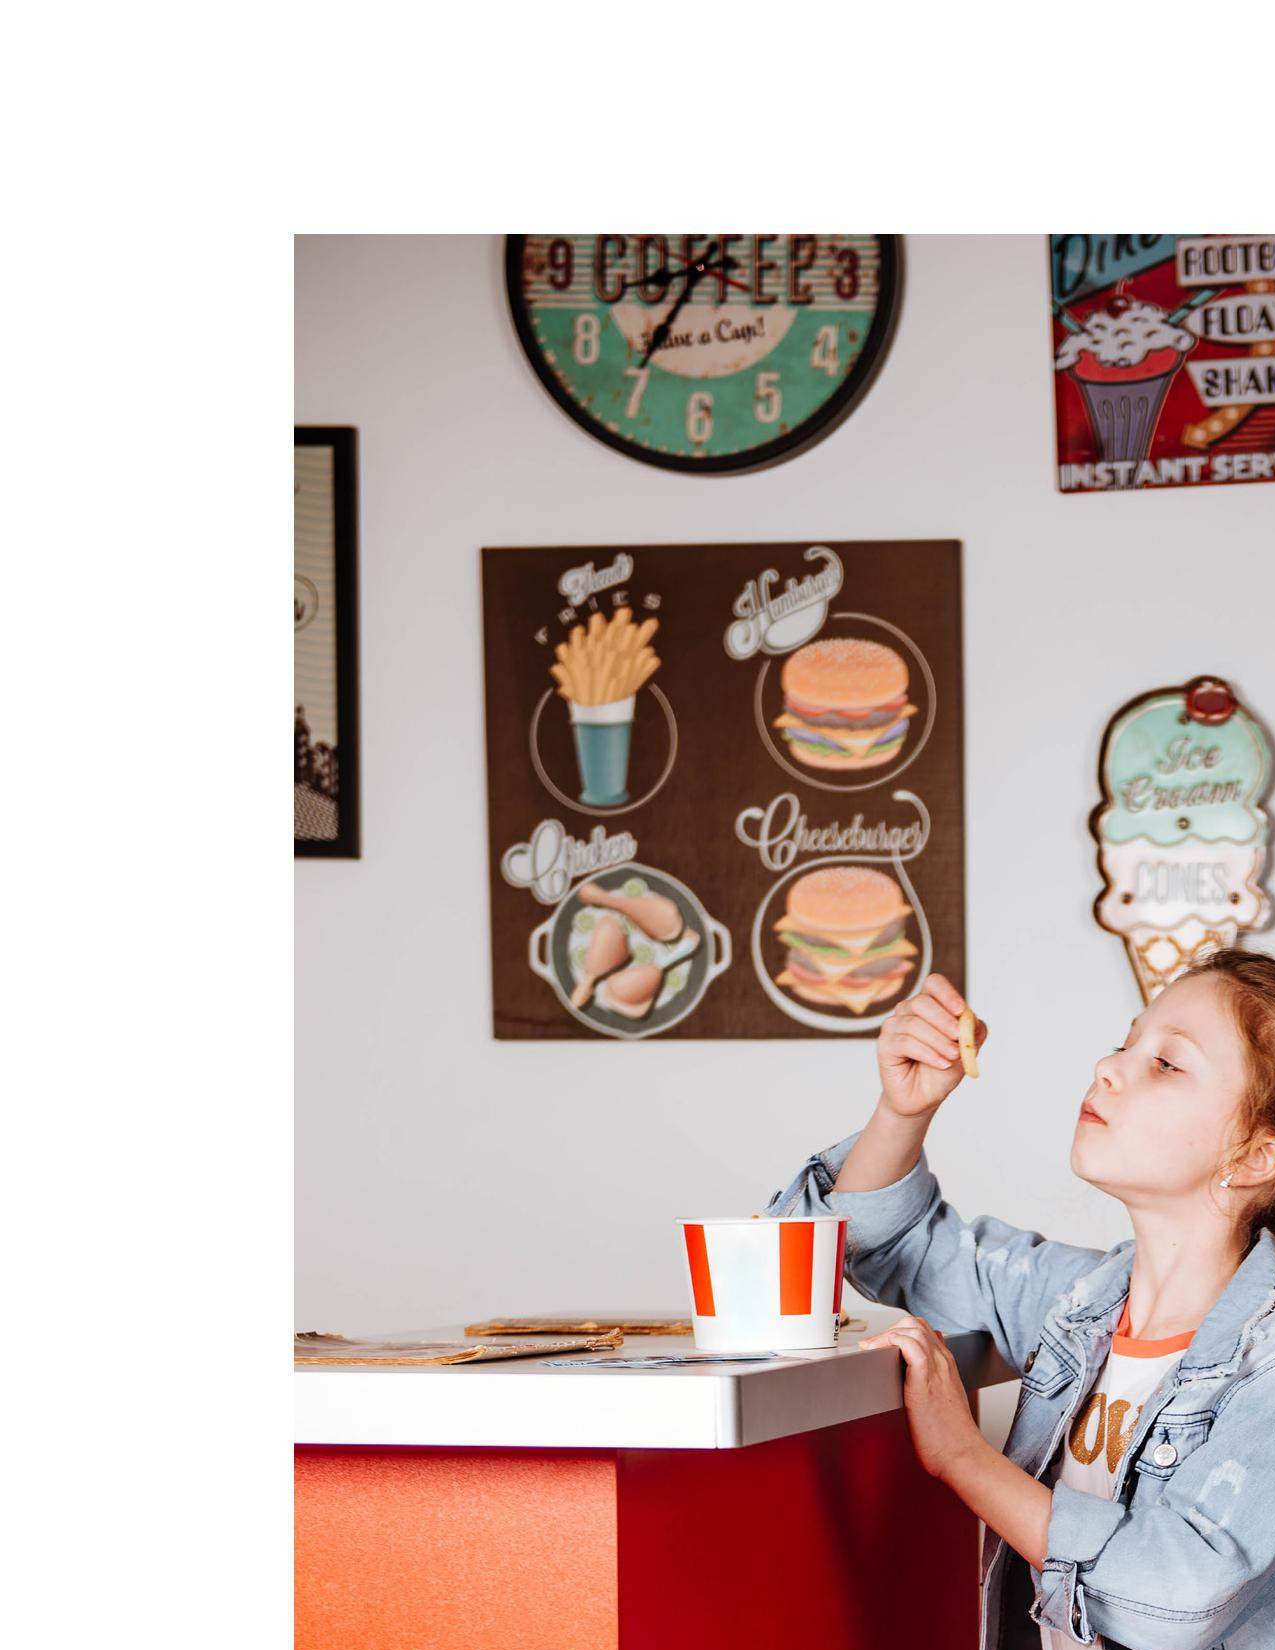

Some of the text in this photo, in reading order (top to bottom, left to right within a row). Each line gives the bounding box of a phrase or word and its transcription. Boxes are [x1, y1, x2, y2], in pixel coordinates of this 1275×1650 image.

[547, 240, 573, 290] 9
[834, 249, 860, 299] 3
[573, 314, 599, 364] 8
[811, 324, 839, 376] 4
[624, 367, 650, 418] 7
[685, 391, 714, 443] 6
[754, 372, 781, 423] 5
[1059, 455, 1208, 489] INSTANT
[1157, 735, 1222, 775] Ice
[1121, 776, 1245, 813] Cream
[1136, 862, 1230, 905] CONES
